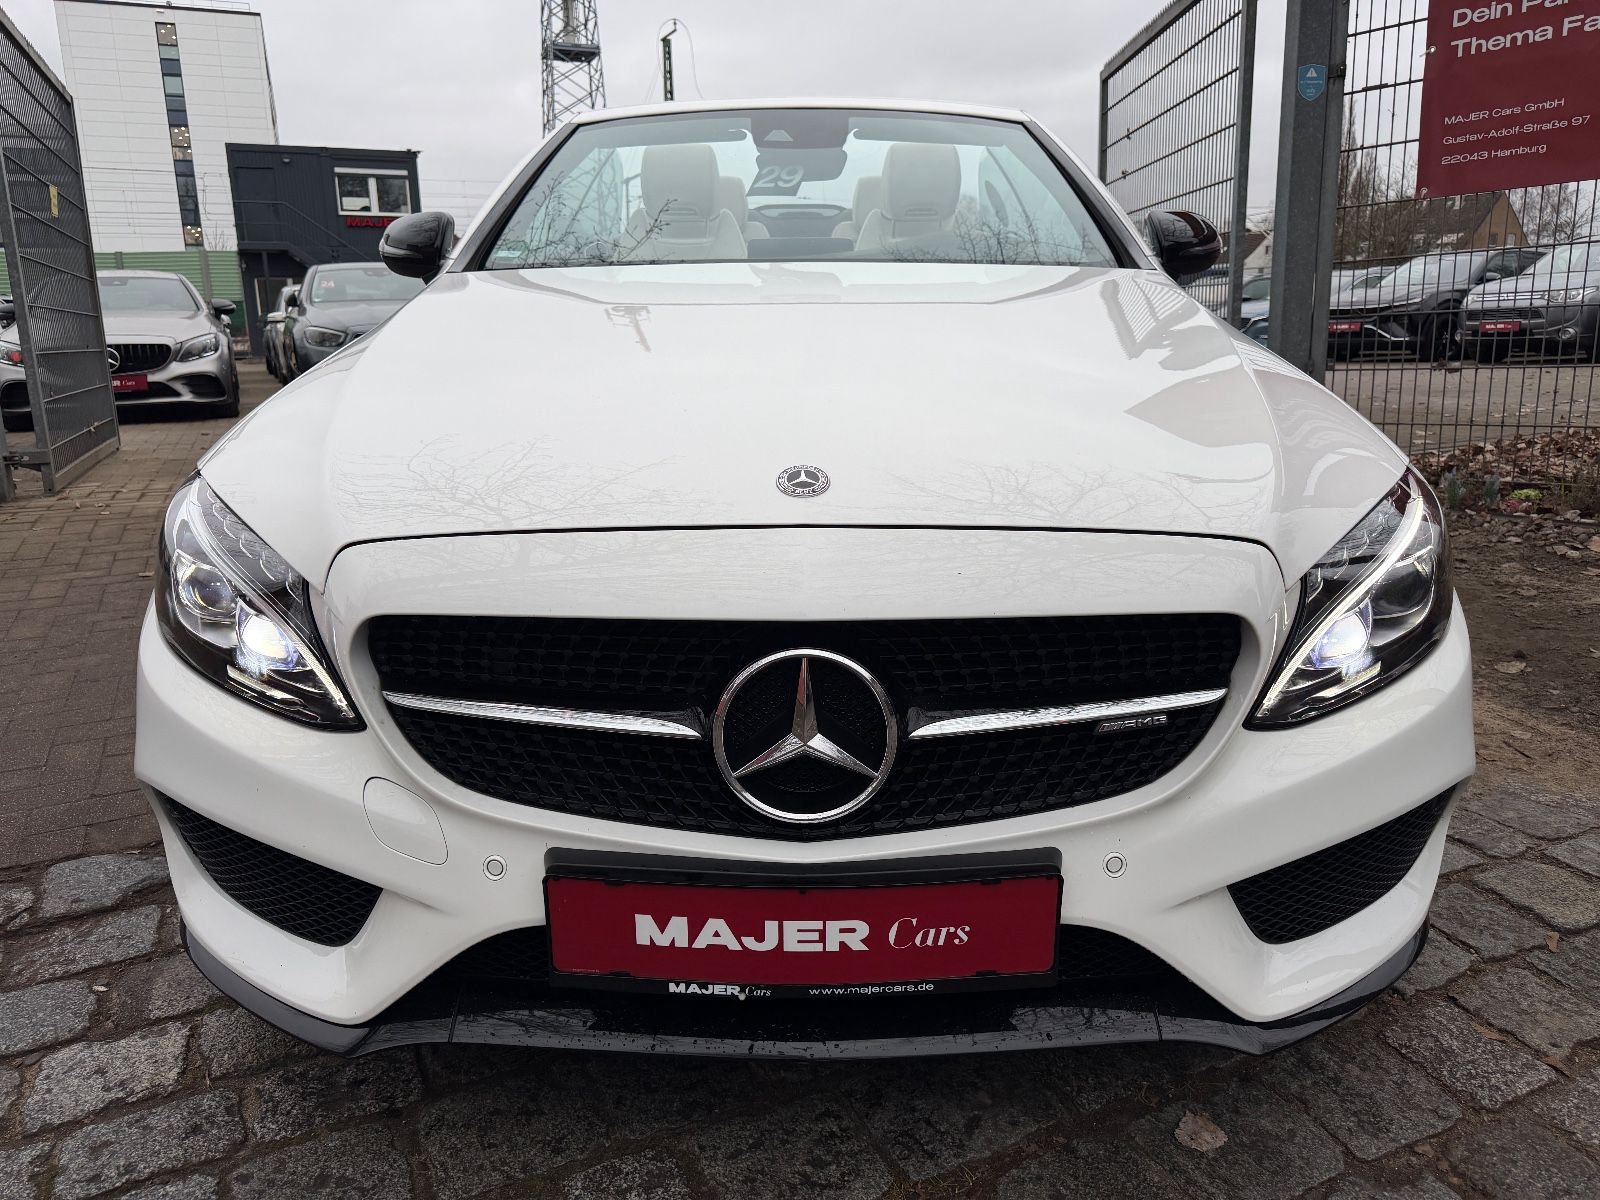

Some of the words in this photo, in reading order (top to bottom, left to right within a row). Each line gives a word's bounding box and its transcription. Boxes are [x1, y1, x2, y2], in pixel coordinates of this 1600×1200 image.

[1452, 1, 1513, 28] Dein
[1521, 0, 1569, 13] Pa
[1450, 25, 1553, 58] Thema
[1444, 111, 1489, 125] MAJER
[1492, 106, 1521, 117] Cars
[1524, 97, 1565, 112] GmbH
[1443, 119, 1568, 145] Gustav-Adolf-Straße
[1571, 115, 1591, 126] 97
[1441, 151, 1489, 165] 22043
[1491, 144, 1547, 158] Hamburg
[754, 165, 804, 188] 29
[346, 215, 393, 228] MAJE
[634, 913, 870, 952] MAJER
[888, 917, 971, 949] Cars
[668, 982, 741, 996] MAJER
[745, 986, 772, 997] Cars
[808, 982, 935, 995] www.majercars.de
